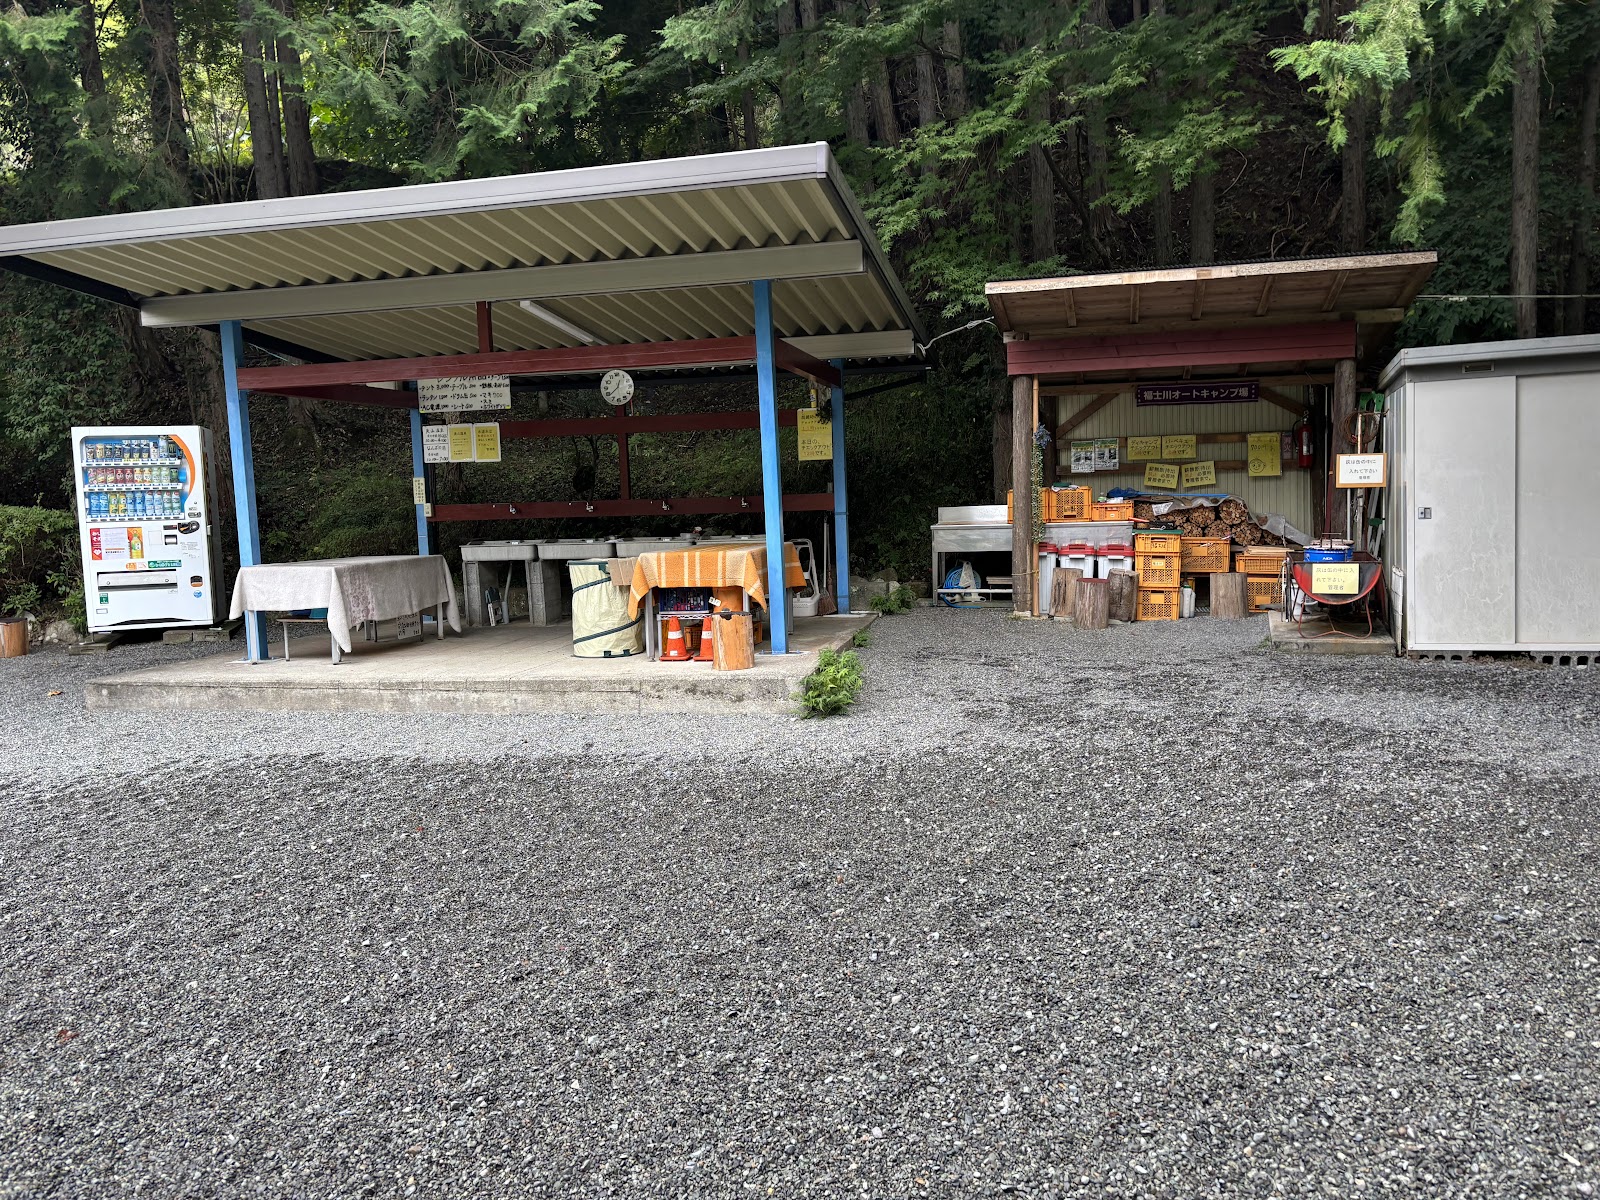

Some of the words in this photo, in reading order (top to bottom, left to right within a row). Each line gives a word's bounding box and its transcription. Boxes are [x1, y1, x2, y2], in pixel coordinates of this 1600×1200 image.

[1144, 387, 1249, 400] 福士川オートキャンプ場
